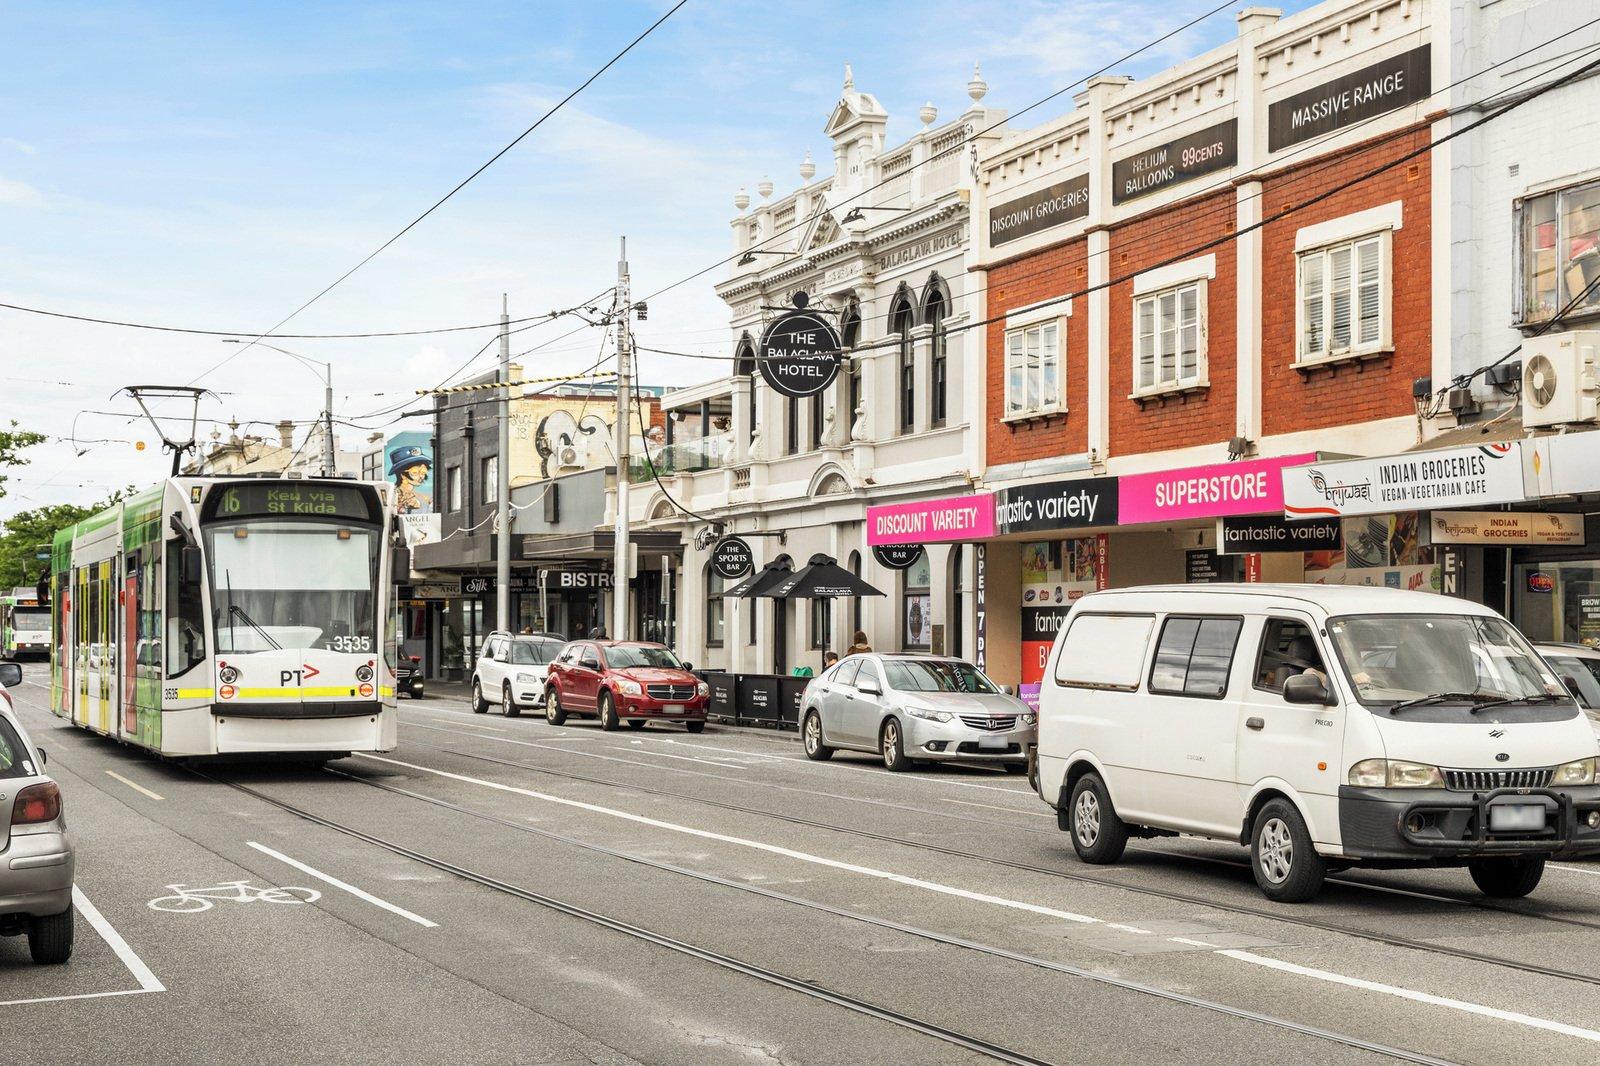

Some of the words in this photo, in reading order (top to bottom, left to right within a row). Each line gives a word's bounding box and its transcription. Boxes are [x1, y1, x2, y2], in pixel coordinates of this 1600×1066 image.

[1291, 92, 1351, 129] MASSIVE
[1353, 70, 1404, 106] RANGE
[1132, 149, 1168, 174] HELIUM
[1125, 165, 1175, 195] BALLOONS
[991, 203, 1034, 234] DISCOUNT
[1035, 187, 1089, 219] GROCERIES
[933, 230, 961, 252] HOTEL
[789, 333, 816, 344] THE
[778, 365, 823, 377] HOTEL
[1379, 462, 1418, 484] INDIAN
[1421, 455, 1486, 480] GROCERIES
[267, 490, 301, 501] Kew
[309, 490, 336, 501] via
[1154, 472, 1268, 508] SUPERSTORE
[1381, 484, 1461, 502] VEGAN-VEGETARIAN
[1464, 480, 1487, 495] CAFE
[224, 490, 240, 512] 16
[267, 502, 287, 513] St
[293, 502, 337, 513] Kilda
[1036, 489, 1099, 522] variety
[876, 512, 927, 536] DISCOUNT
[931, 508, 978, 531] VARIETY
[1490, 519, 1518, 527] INDIAN
[1225, 525, 1287, 542] fantastic
[1290, 524, 1338, 542] variety
[1483, 529, 1528, 538] GROCERIES
[718, 554, 747, 562] SPORTS
[466, 578, 487, 593] Silk
[1408, 571, 1424, 590] AJAX
[977, 612, 984, 630] 7
[333, 636, 370, 651] 3535
[165, 688, 178, 700] 3535
